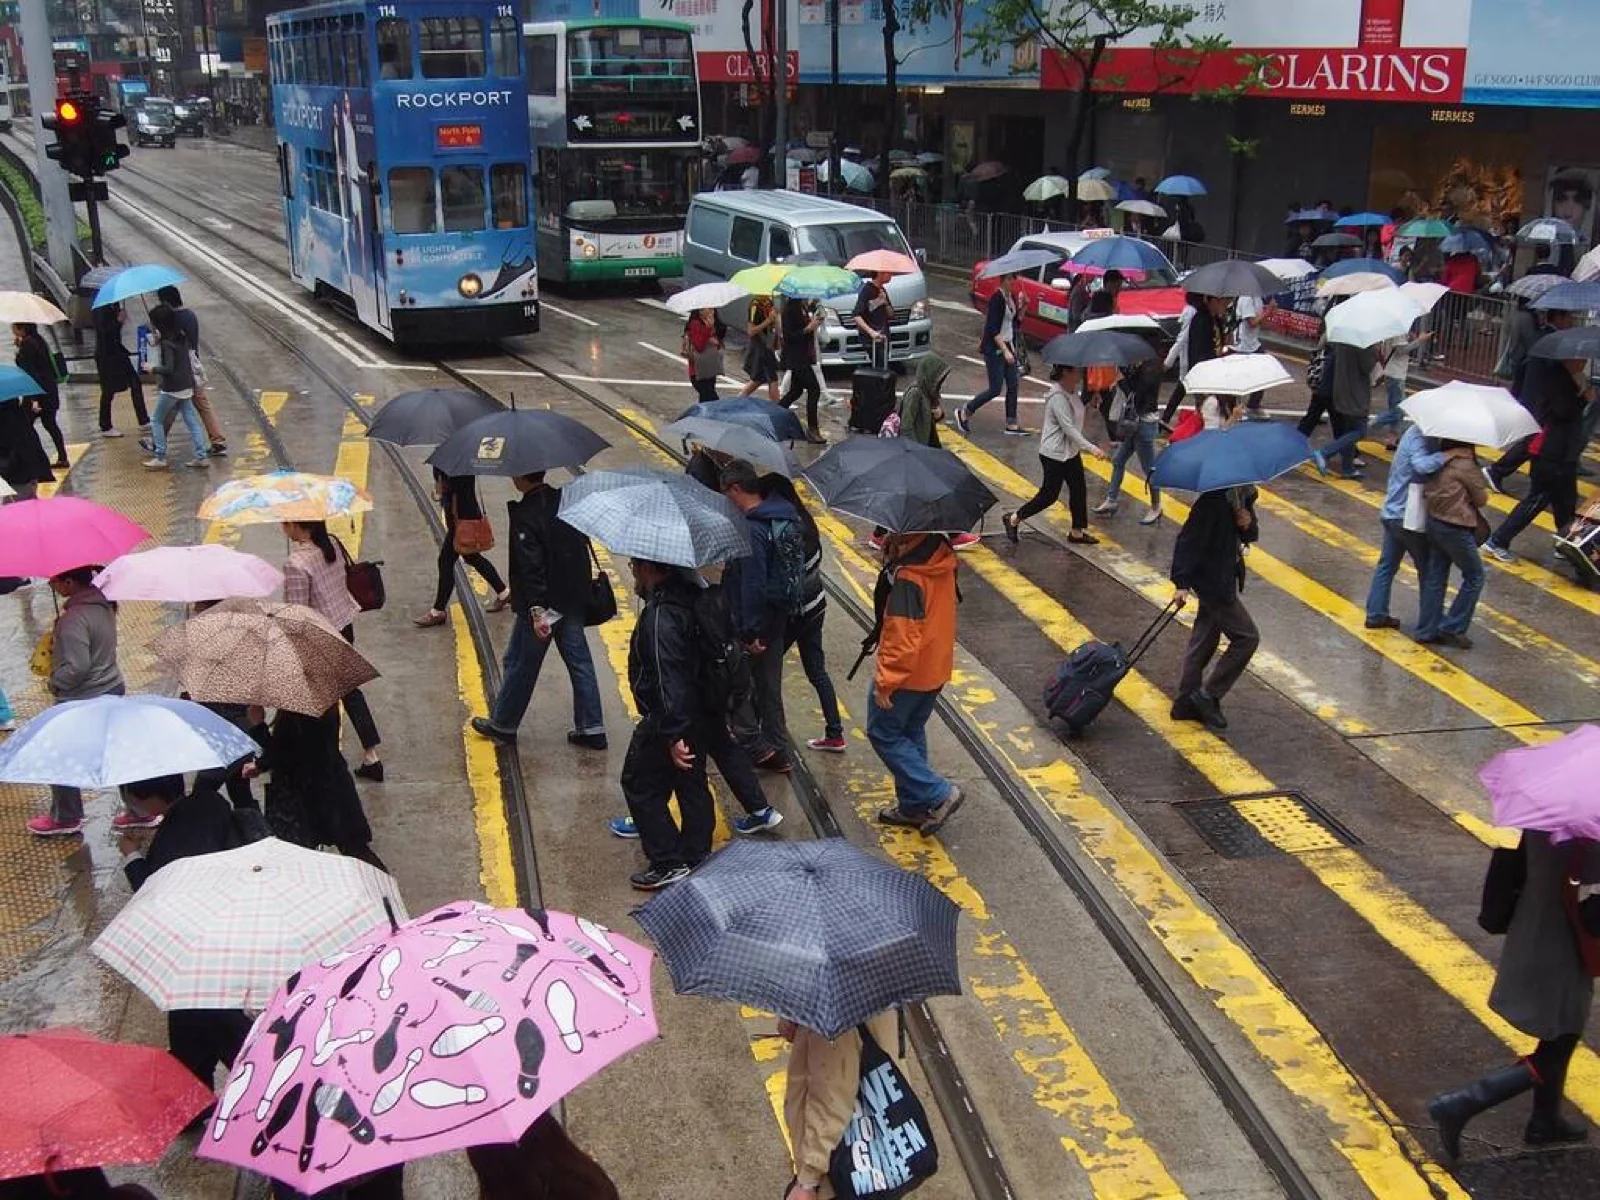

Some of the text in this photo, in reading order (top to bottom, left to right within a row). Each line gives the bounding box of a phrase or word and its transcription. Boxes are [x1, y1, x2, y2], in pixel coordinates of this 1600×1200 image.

[378, 5, 396, 17] 114
[497, 5, 513, 17] 114
[725, 54, 795, 77] CLARIS
[1257, 53, 1451, 94] CLARINS
[396, 91, 512, 109] ROCKPORT
[524, 304, 537, 318] 114
